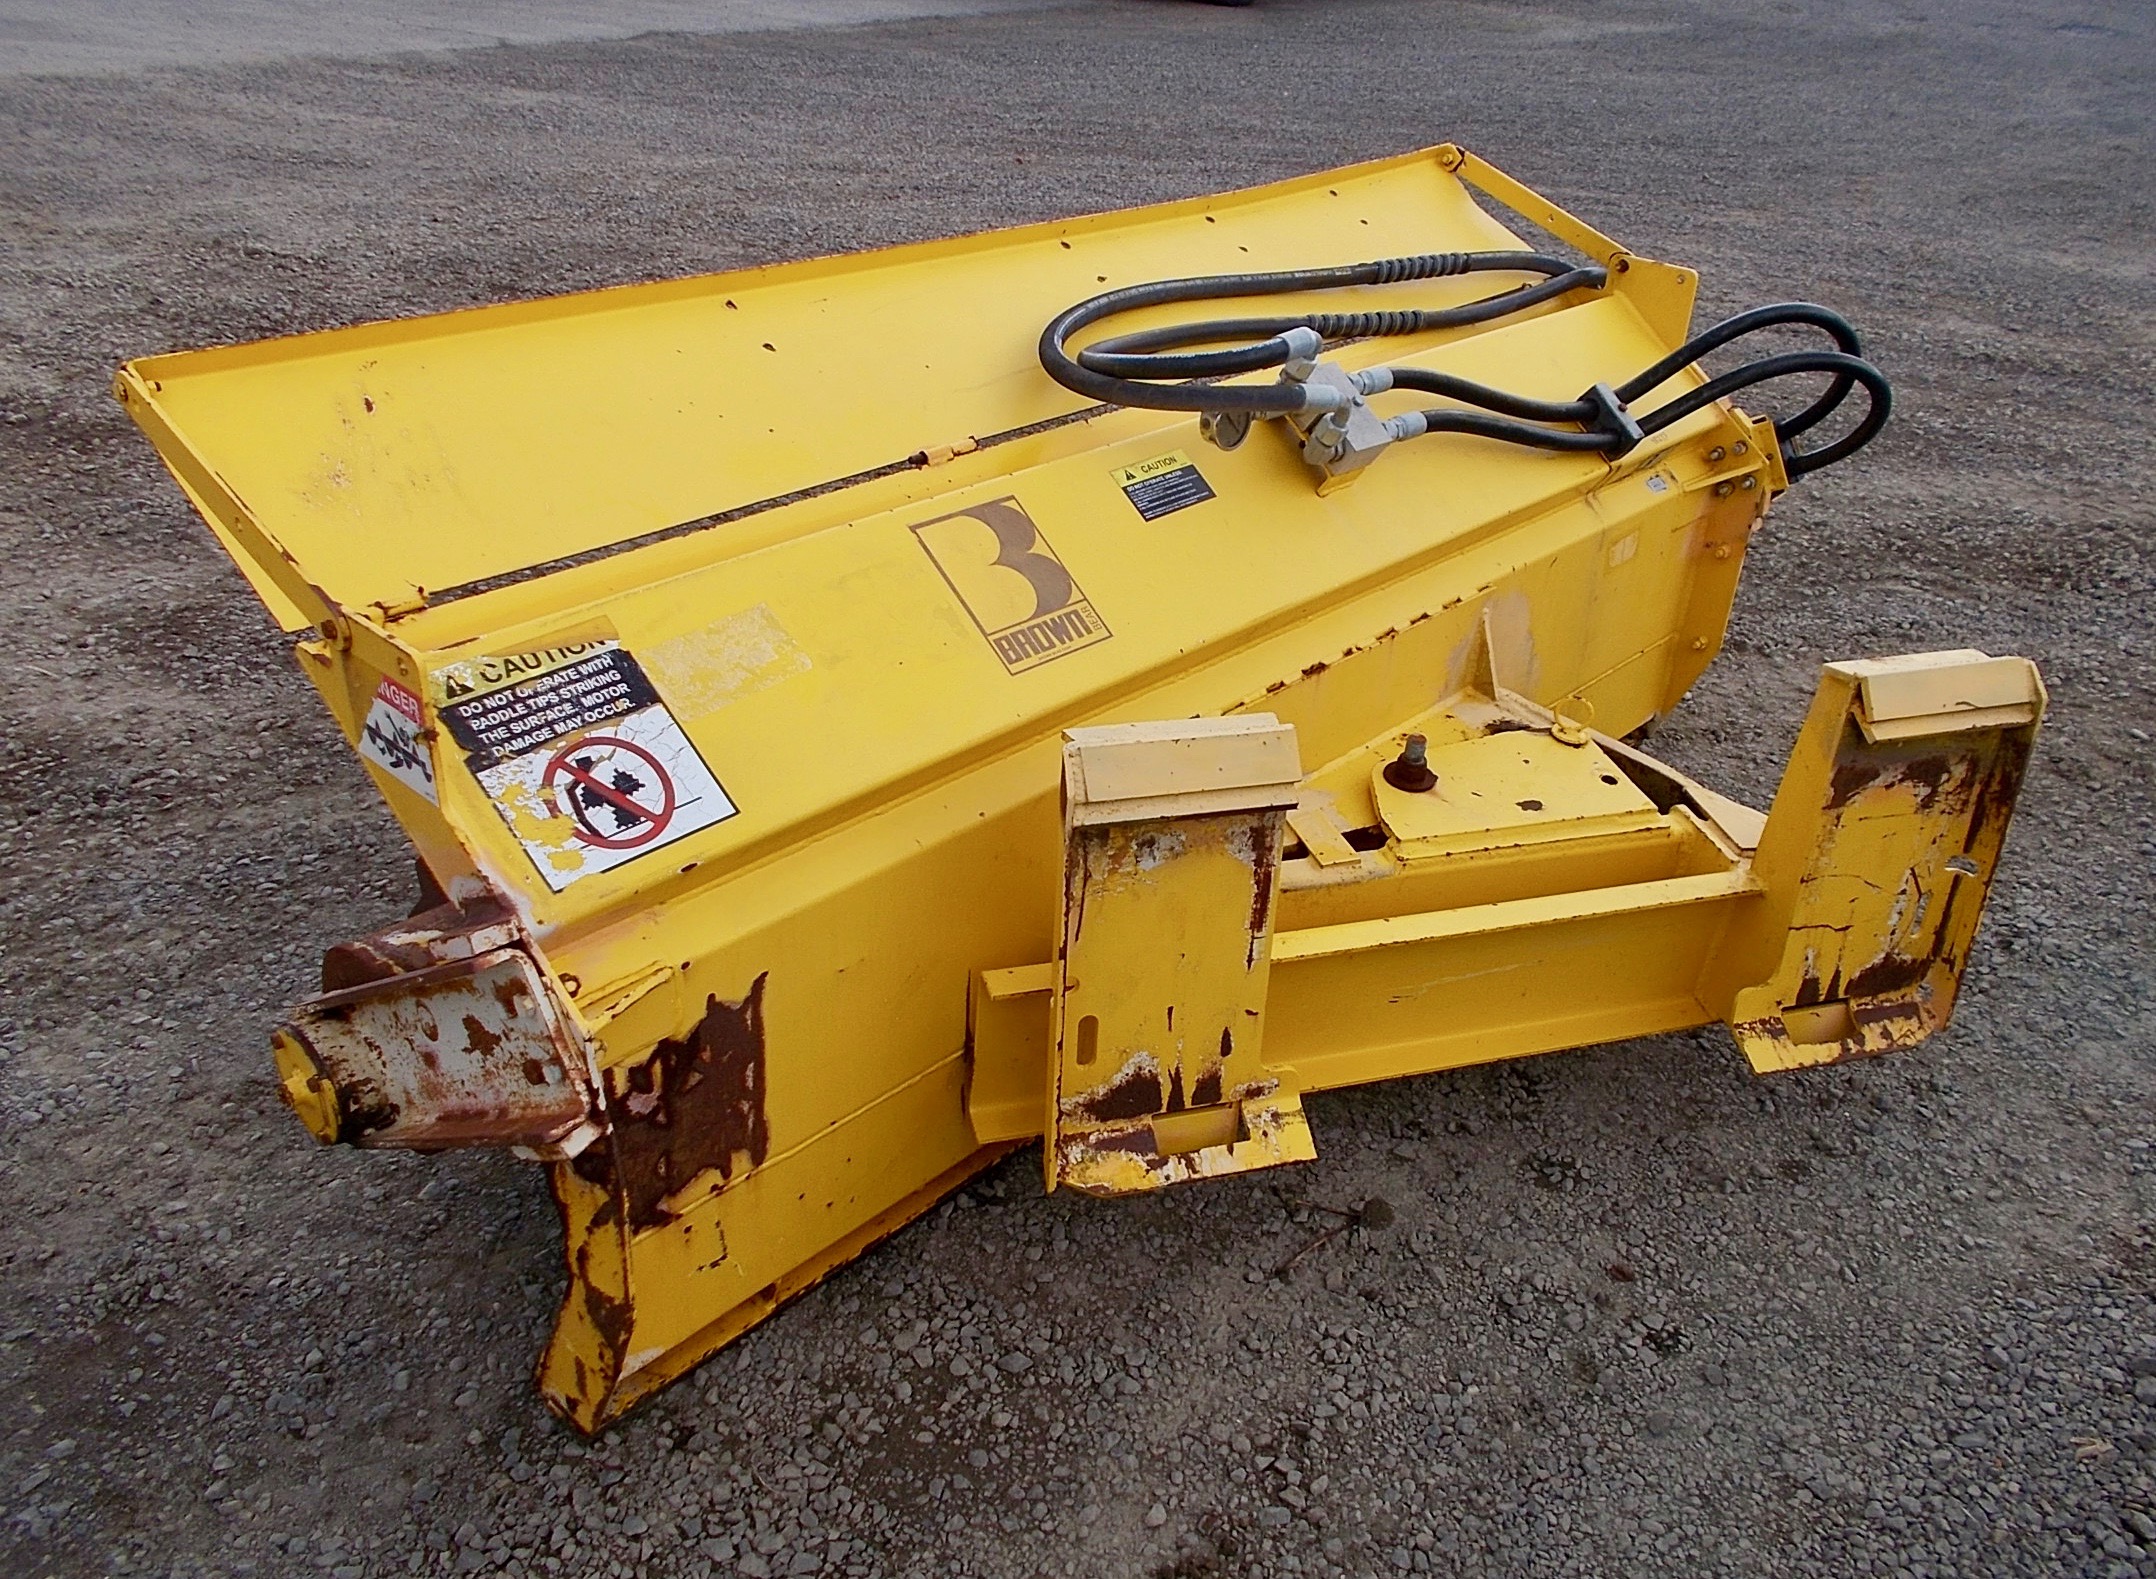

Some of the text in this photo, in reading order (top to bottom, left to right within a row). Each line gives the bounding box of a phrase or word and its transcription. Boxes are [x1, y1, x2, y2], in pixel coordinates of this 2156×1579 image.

[1140, 456, 1178, 473] CAUTION
[993, 609, 1093, 665] BROWN
[1080, 605, 1103, 631] BEAR
[378, 681, 420, 714] NGER
[458, 701, 483, 718] DO
[486, 689, 515, 710] NOT
[580, 654, 614, 676] WITH
[470, 669, 622, 732] PADDLE TIPS STRIKING
[478, 682, 631, 745] THE SURFACE. MOTOR
[491, 697, 636, 758] DAMAGE MAY OCCUR.
